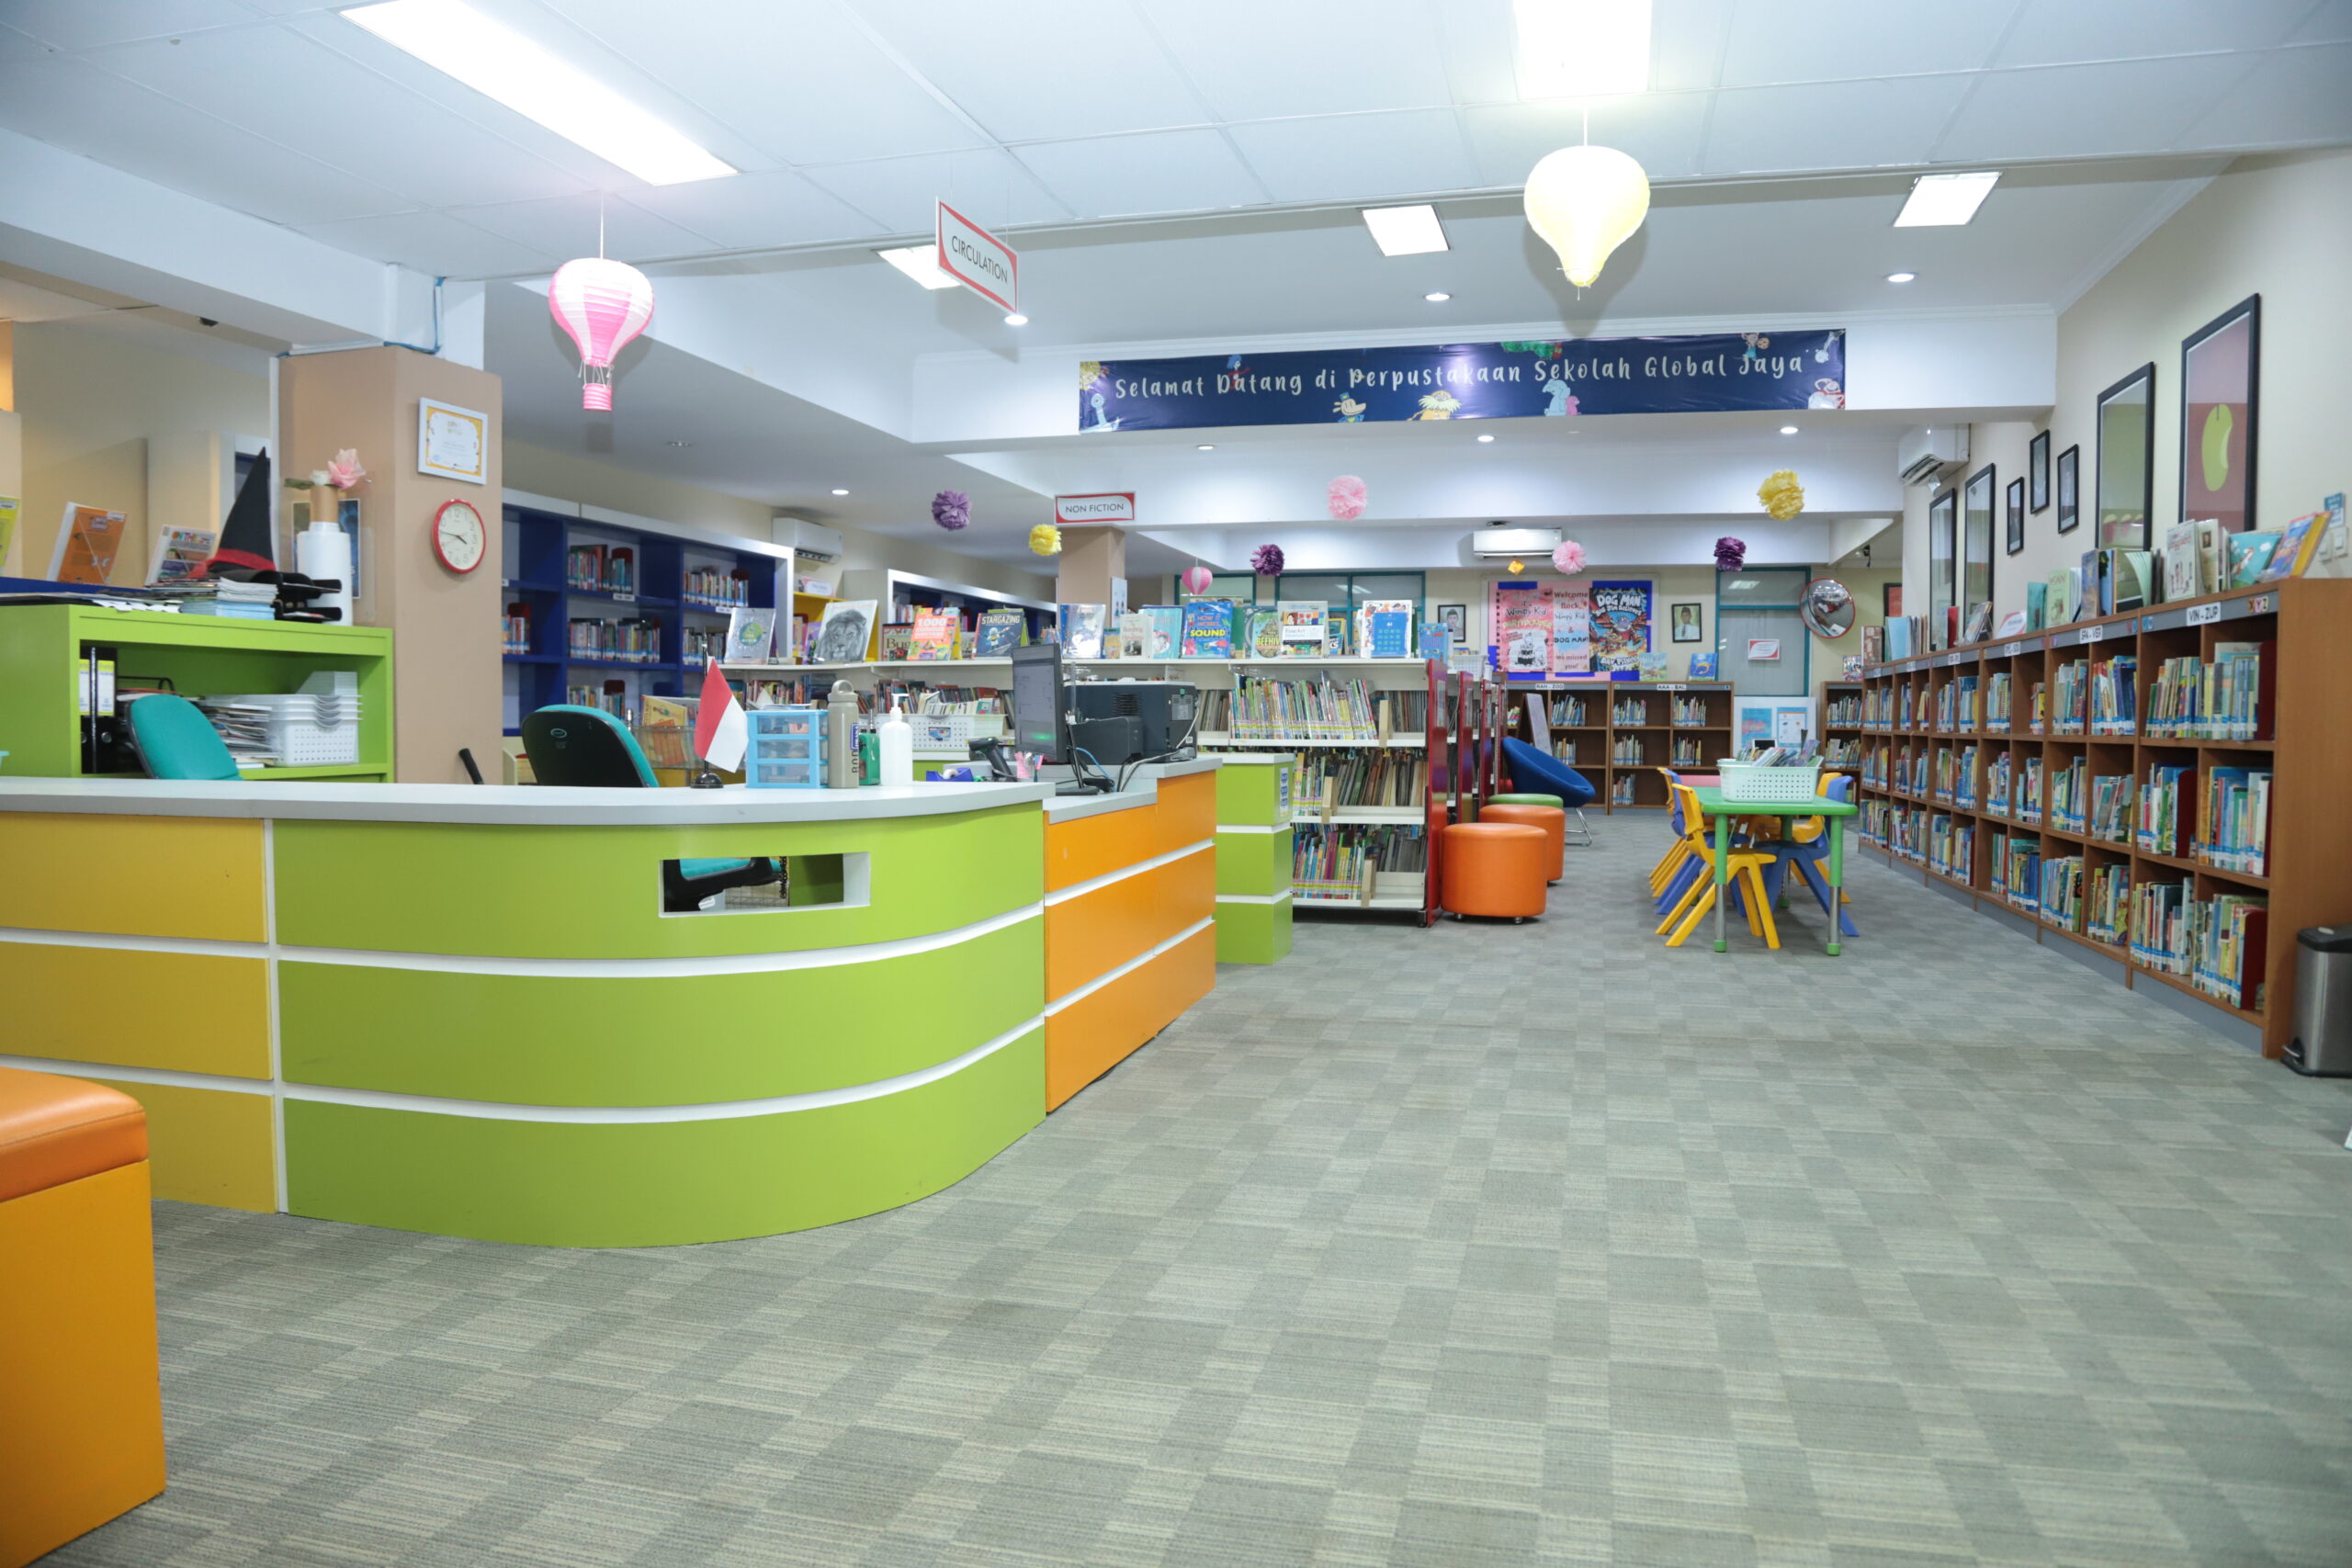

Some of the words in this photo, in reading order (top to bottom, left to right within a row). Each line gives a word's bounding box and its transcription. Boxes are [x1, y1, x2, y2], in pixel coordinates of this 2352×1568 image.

[952, 235, 1008, 285] CIRCULATION
[1115, 374, 1204, 399] Selamat
[1216, 373, 1302, 395] Datang
[1315, 369, 1336, 389] di
[1350, 365, 1521, 391] Perpustakaan
[1534, 358, 1631, 381] Sekolah
[1645, 354, 1727, 378] Global
[1738, 354, 1803, 378] Jaya
[1066, 504, 1087, 513] NON
[1089, 502, 1125, 513] FICTION
[1596, 594, 1618, 607] DOG
[1620, 594, 1641, 607] MAN
[1506, 607, 1532, 616] Wimpy
[1533, 606, 1547, 615] Kid
[1575, 611, 1585, 619] Kid
[2188, 608, 2201, 622] VIN
[981, 615, 1021, 625] STARGAZING
[1190, 629, 1227, 637] SOUND
[1256, 637, 1279, 646] BEEHIV
